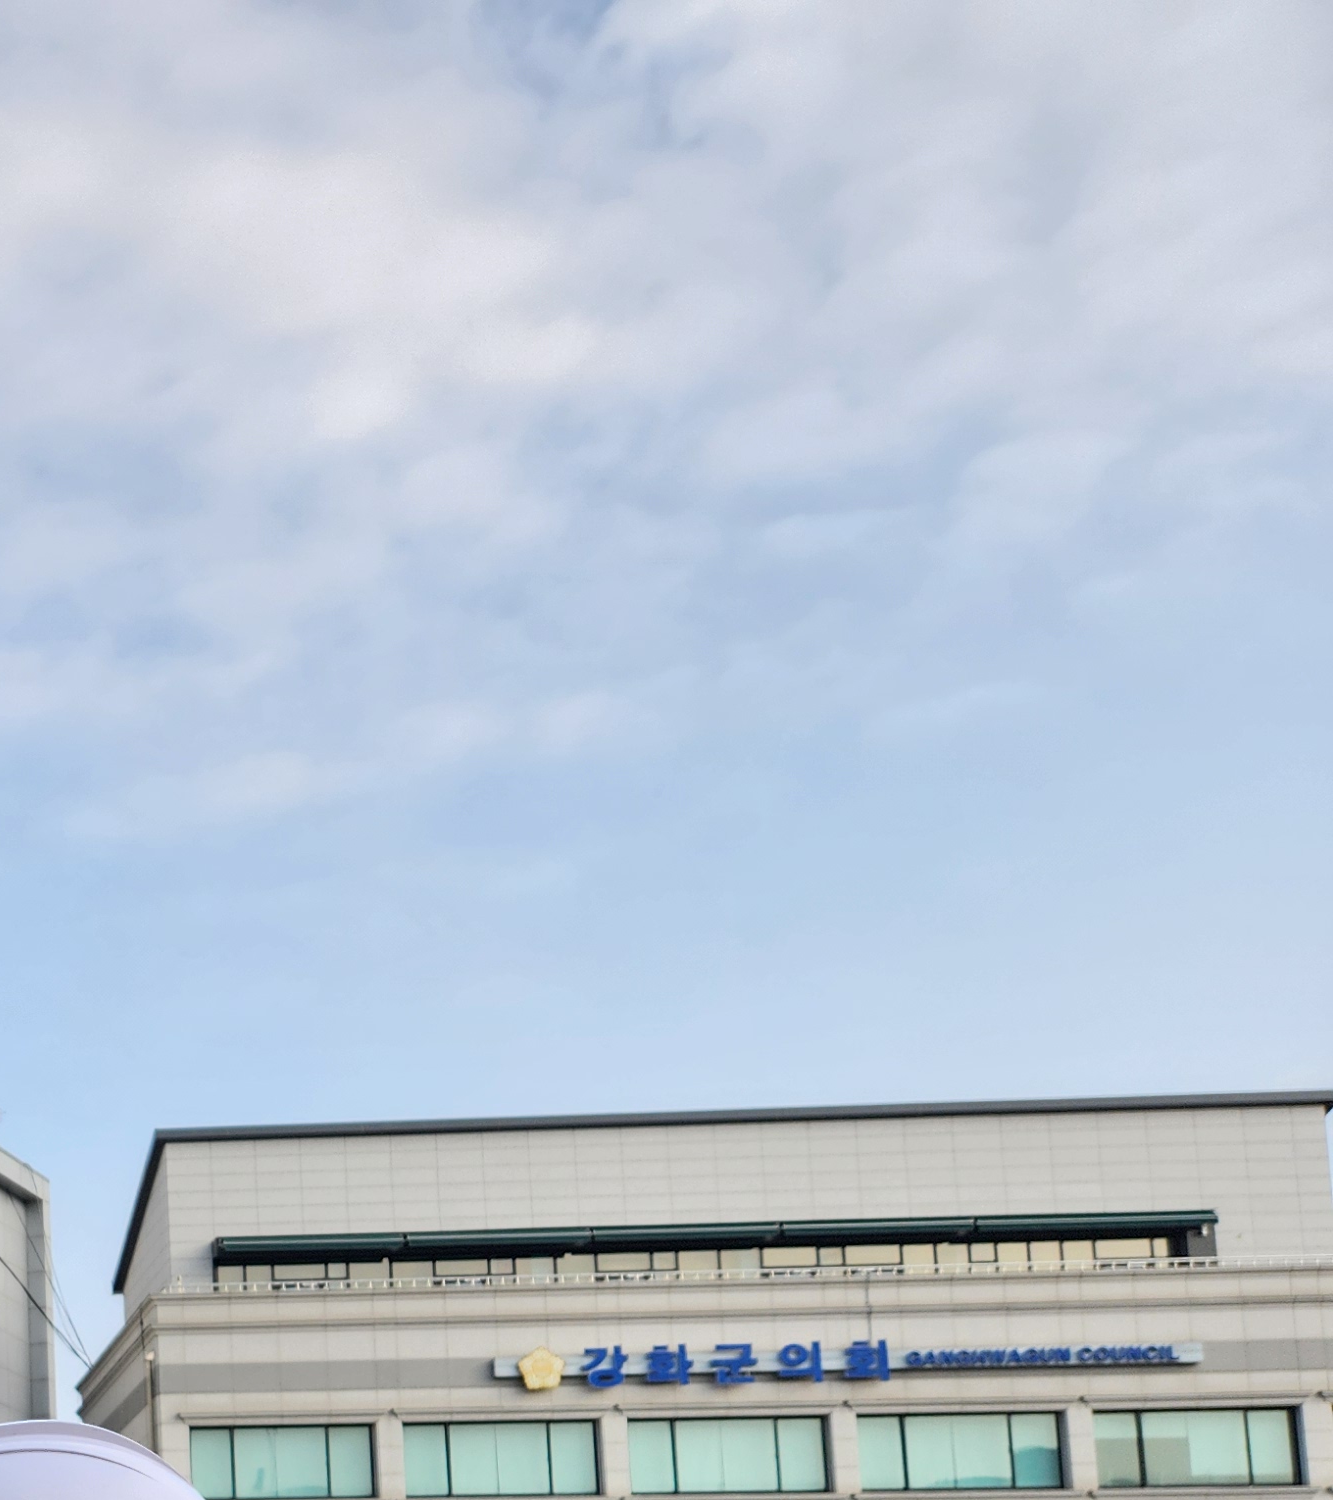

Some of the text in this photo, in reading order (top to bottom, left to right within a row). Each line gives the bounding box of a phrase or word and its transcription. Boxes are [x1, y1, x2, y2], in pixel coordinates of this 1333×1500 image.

[580, 1339, 891, 1388] 강화군의회
[904, 1345, 1180, 1368] GANGHWAGUN COUNCIL
